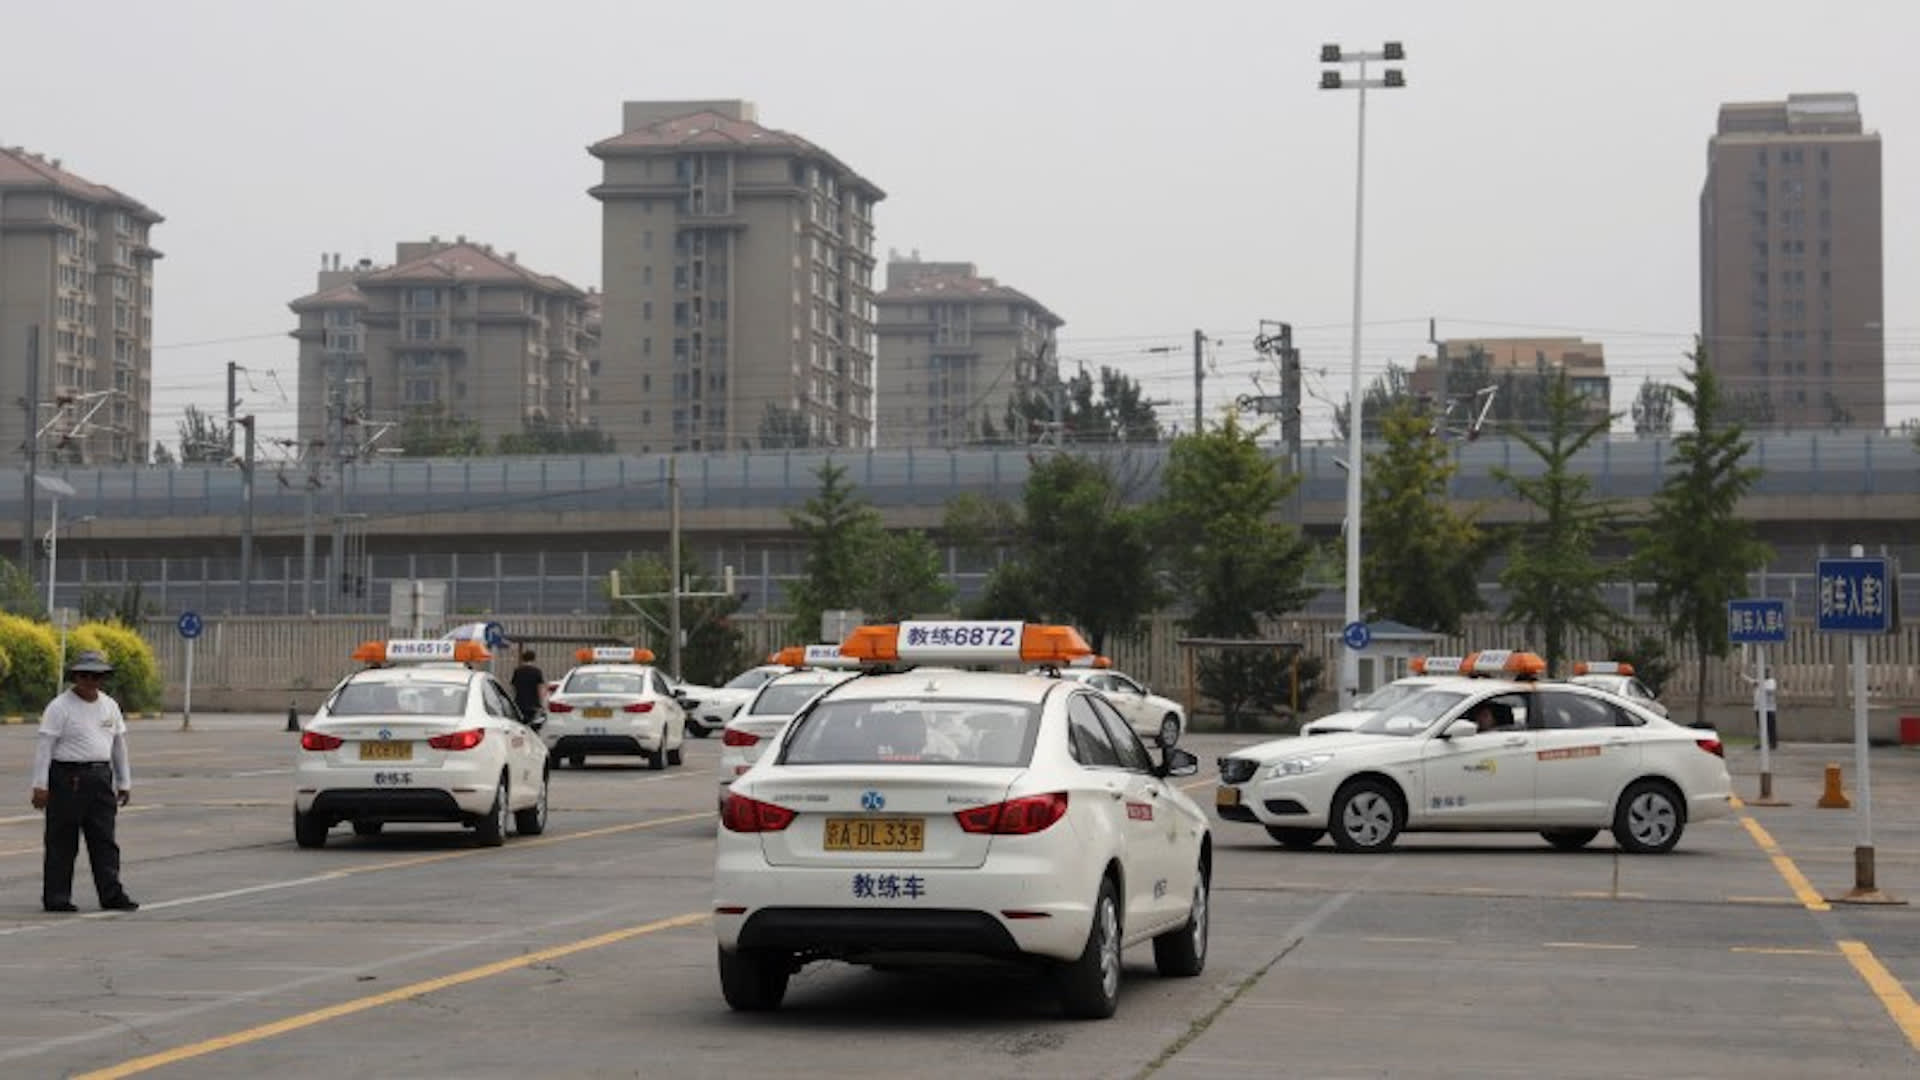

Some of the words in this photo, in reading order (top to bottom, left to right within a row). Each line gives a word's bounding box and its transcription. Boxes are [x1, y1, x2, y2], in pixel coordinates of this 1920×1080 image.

[906, 627, 1015, 647] 教练6872
[852, 872, 926, 900] 教练车
